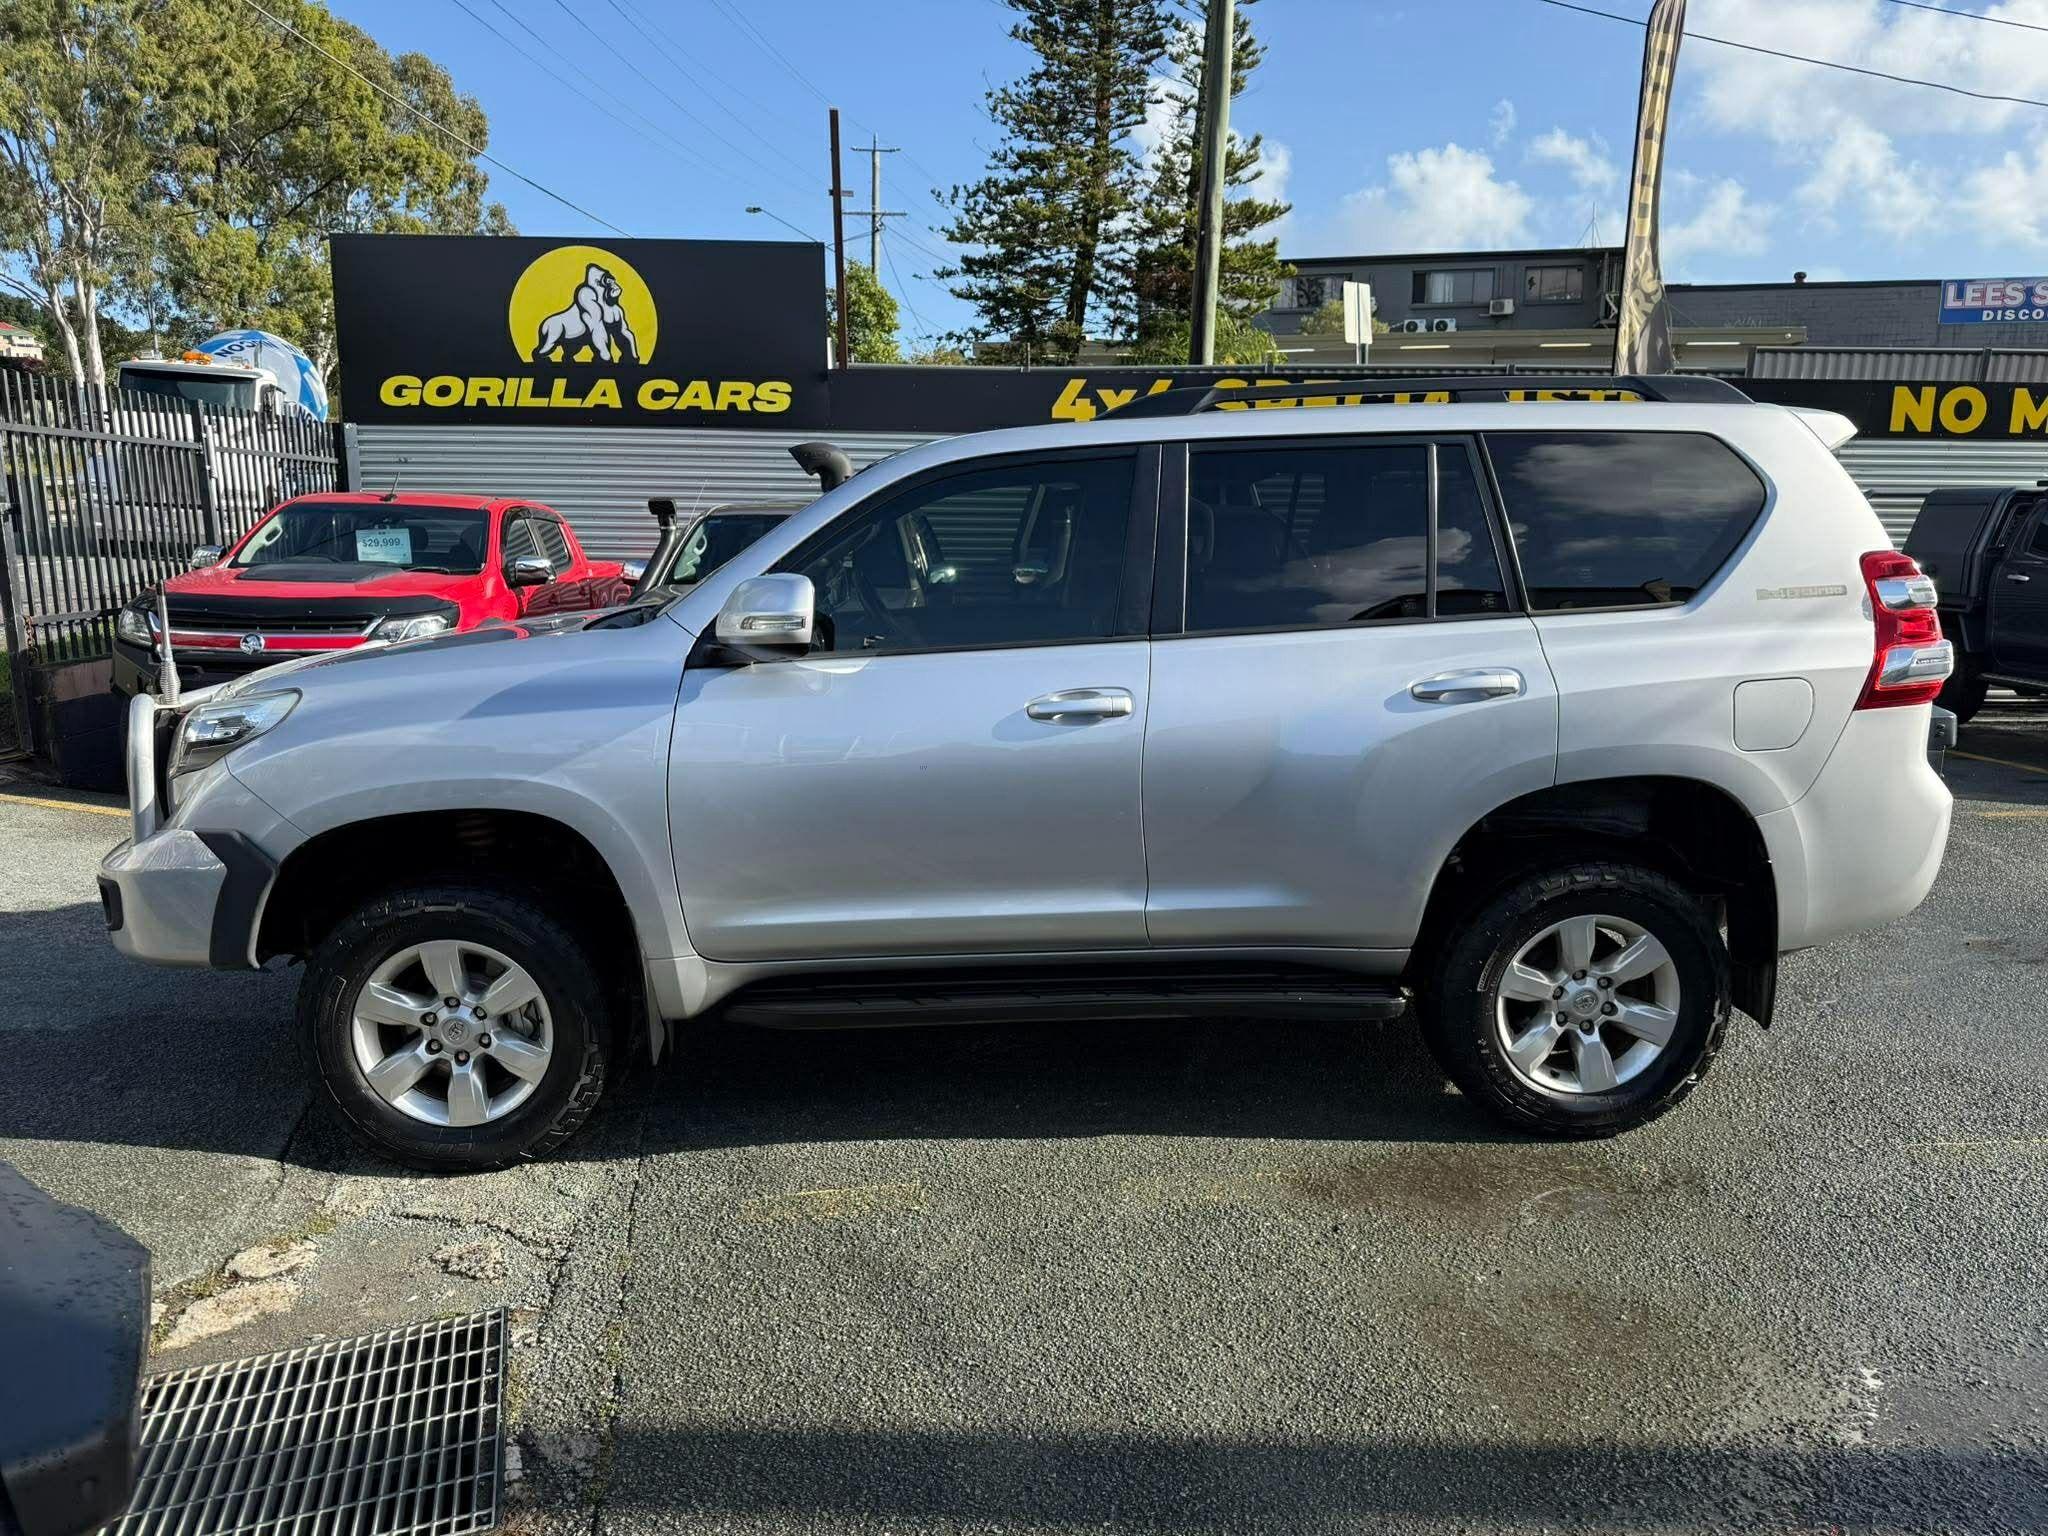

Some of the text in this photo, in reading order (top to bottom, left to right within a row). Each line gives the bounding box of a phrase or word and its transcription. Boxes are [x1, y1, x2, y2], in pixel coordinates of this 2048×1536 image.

[1944, 281, 2026, 308] LEES
[1982, 309, 2048, 321] DISCO
[379, 375, 792, 413] GORILLA CARS
[1889, 386, 1988, 434] NO
